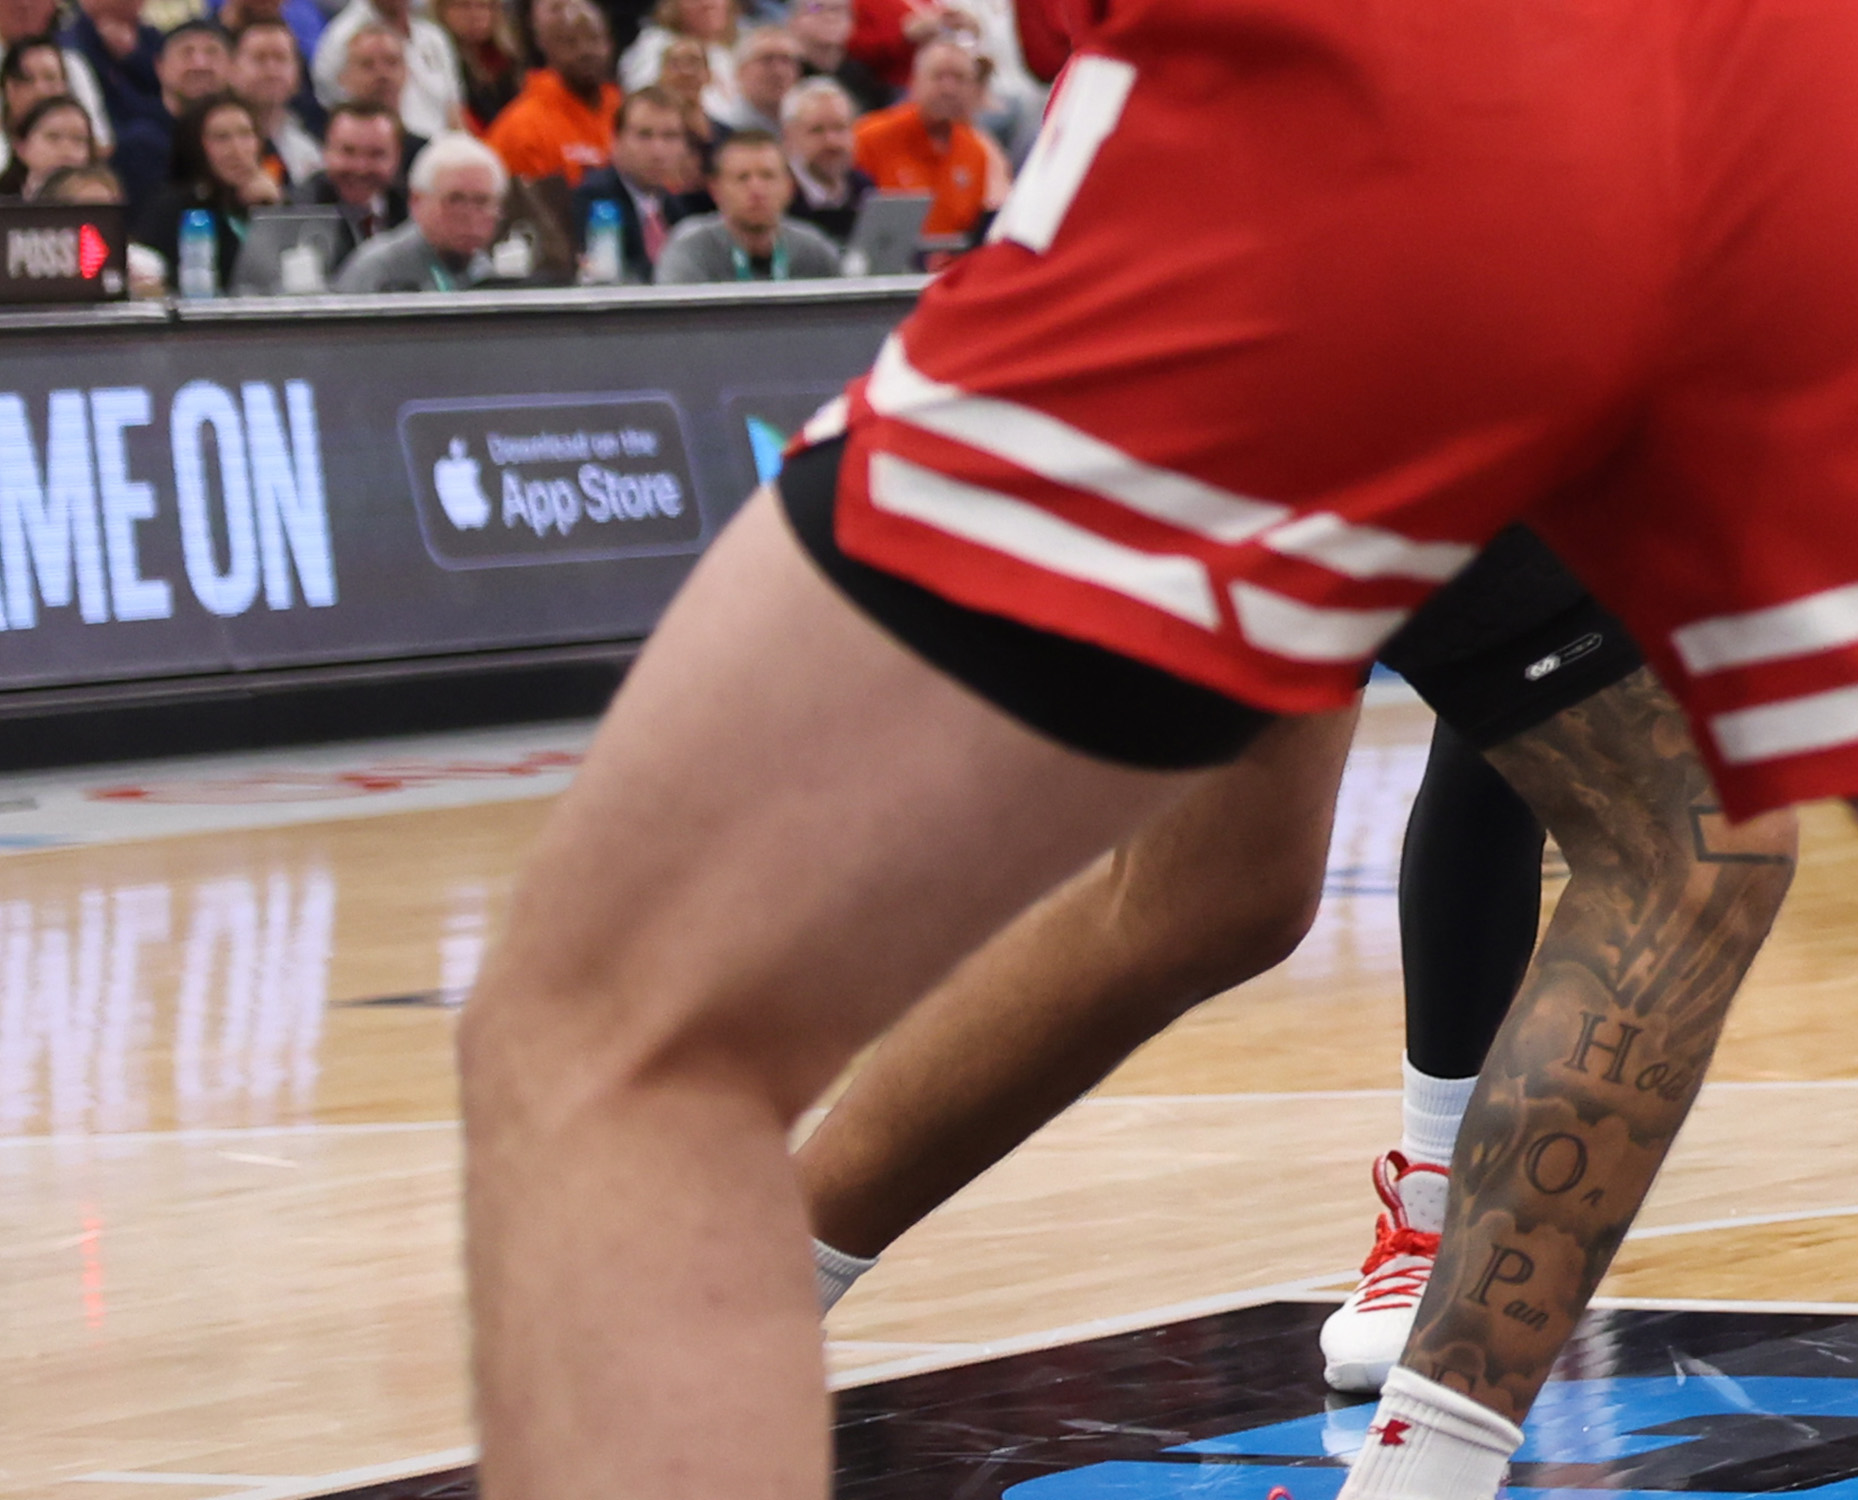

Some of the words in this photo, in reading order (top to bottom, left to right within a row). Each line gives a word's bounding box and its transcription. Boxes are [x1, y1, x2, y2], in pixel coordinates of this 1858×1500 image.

[7, 227, 77, 279] POSS
[0, 386, 174, 631] ME
[170, 378, 338, 618] ON
[502, 468, 582, 538] App
[577, 463, 685, 524] Store
[1466, 1241, 1550, 1332] Pain
